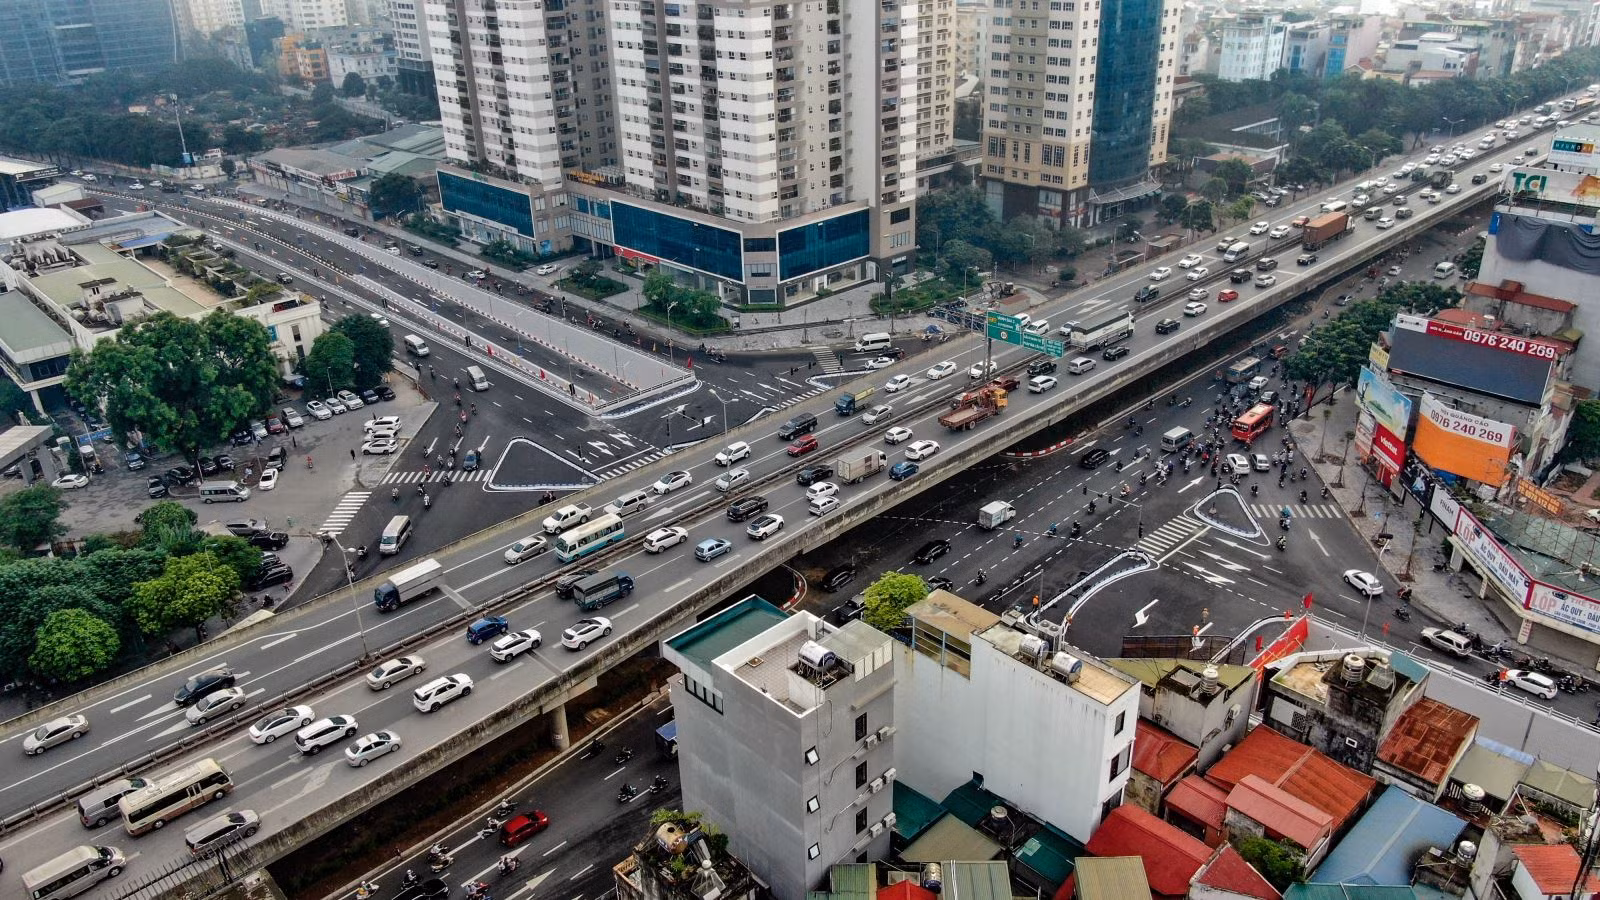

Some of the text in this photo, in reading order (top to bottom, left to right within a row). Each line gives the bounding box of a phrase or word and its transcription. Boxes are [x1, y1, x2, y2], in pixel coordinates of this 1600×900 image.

[1464, 329, 1498, 346] 0976
[1499, 338, 1526, 352] 240
[1528, 343, 1555, 359] 269
[1430, 409, 1503, 443] 0976 240 269
